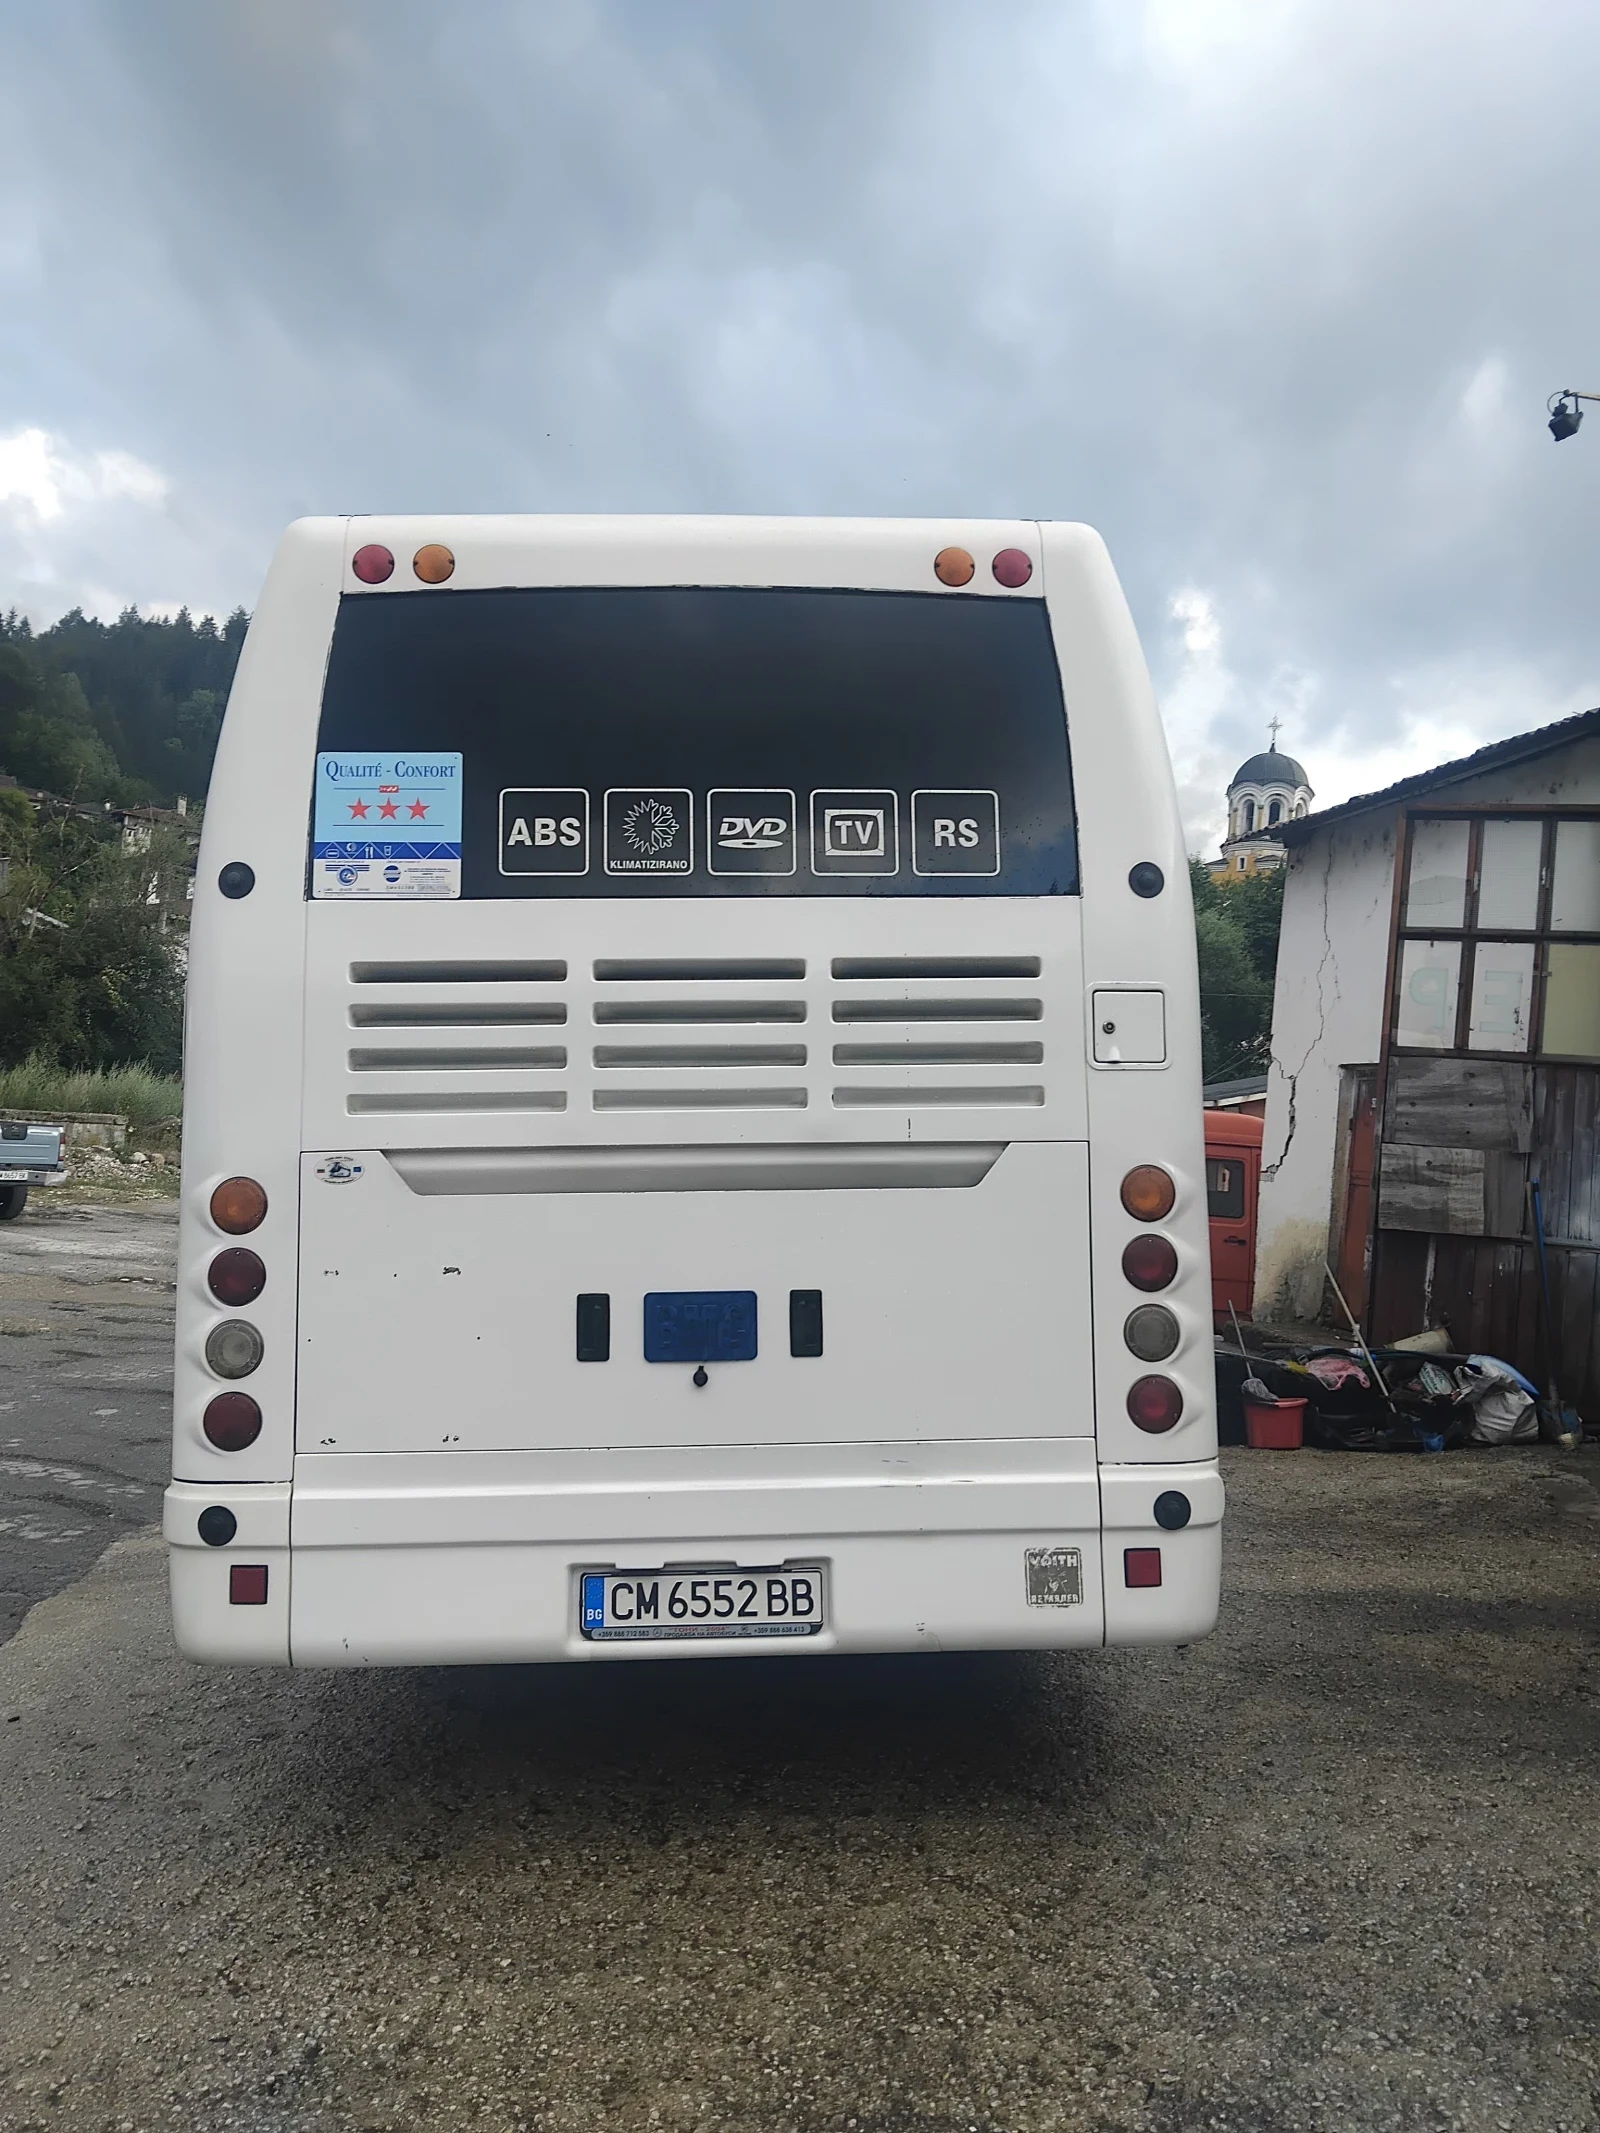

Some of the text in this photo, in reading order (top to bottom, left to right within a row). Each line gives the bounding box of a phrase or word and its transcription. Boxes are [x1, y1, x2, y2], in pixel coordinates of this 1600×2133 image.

[326, 760, 382, 781] QUALITÉ
[395, 760, 456, 778] CONFORT
[507, 817, 582, 847] ABS
[719, 817, 788, 838] DVD
[835, 820, 874, 844] TV
[934, 819, 979, 848] RS
[609, 858, 688, 871] KLIMATIZIRANO
[611, 1578, 814, 1621] CM 6552 BB
[586, 1608, 602, 1621] BG
